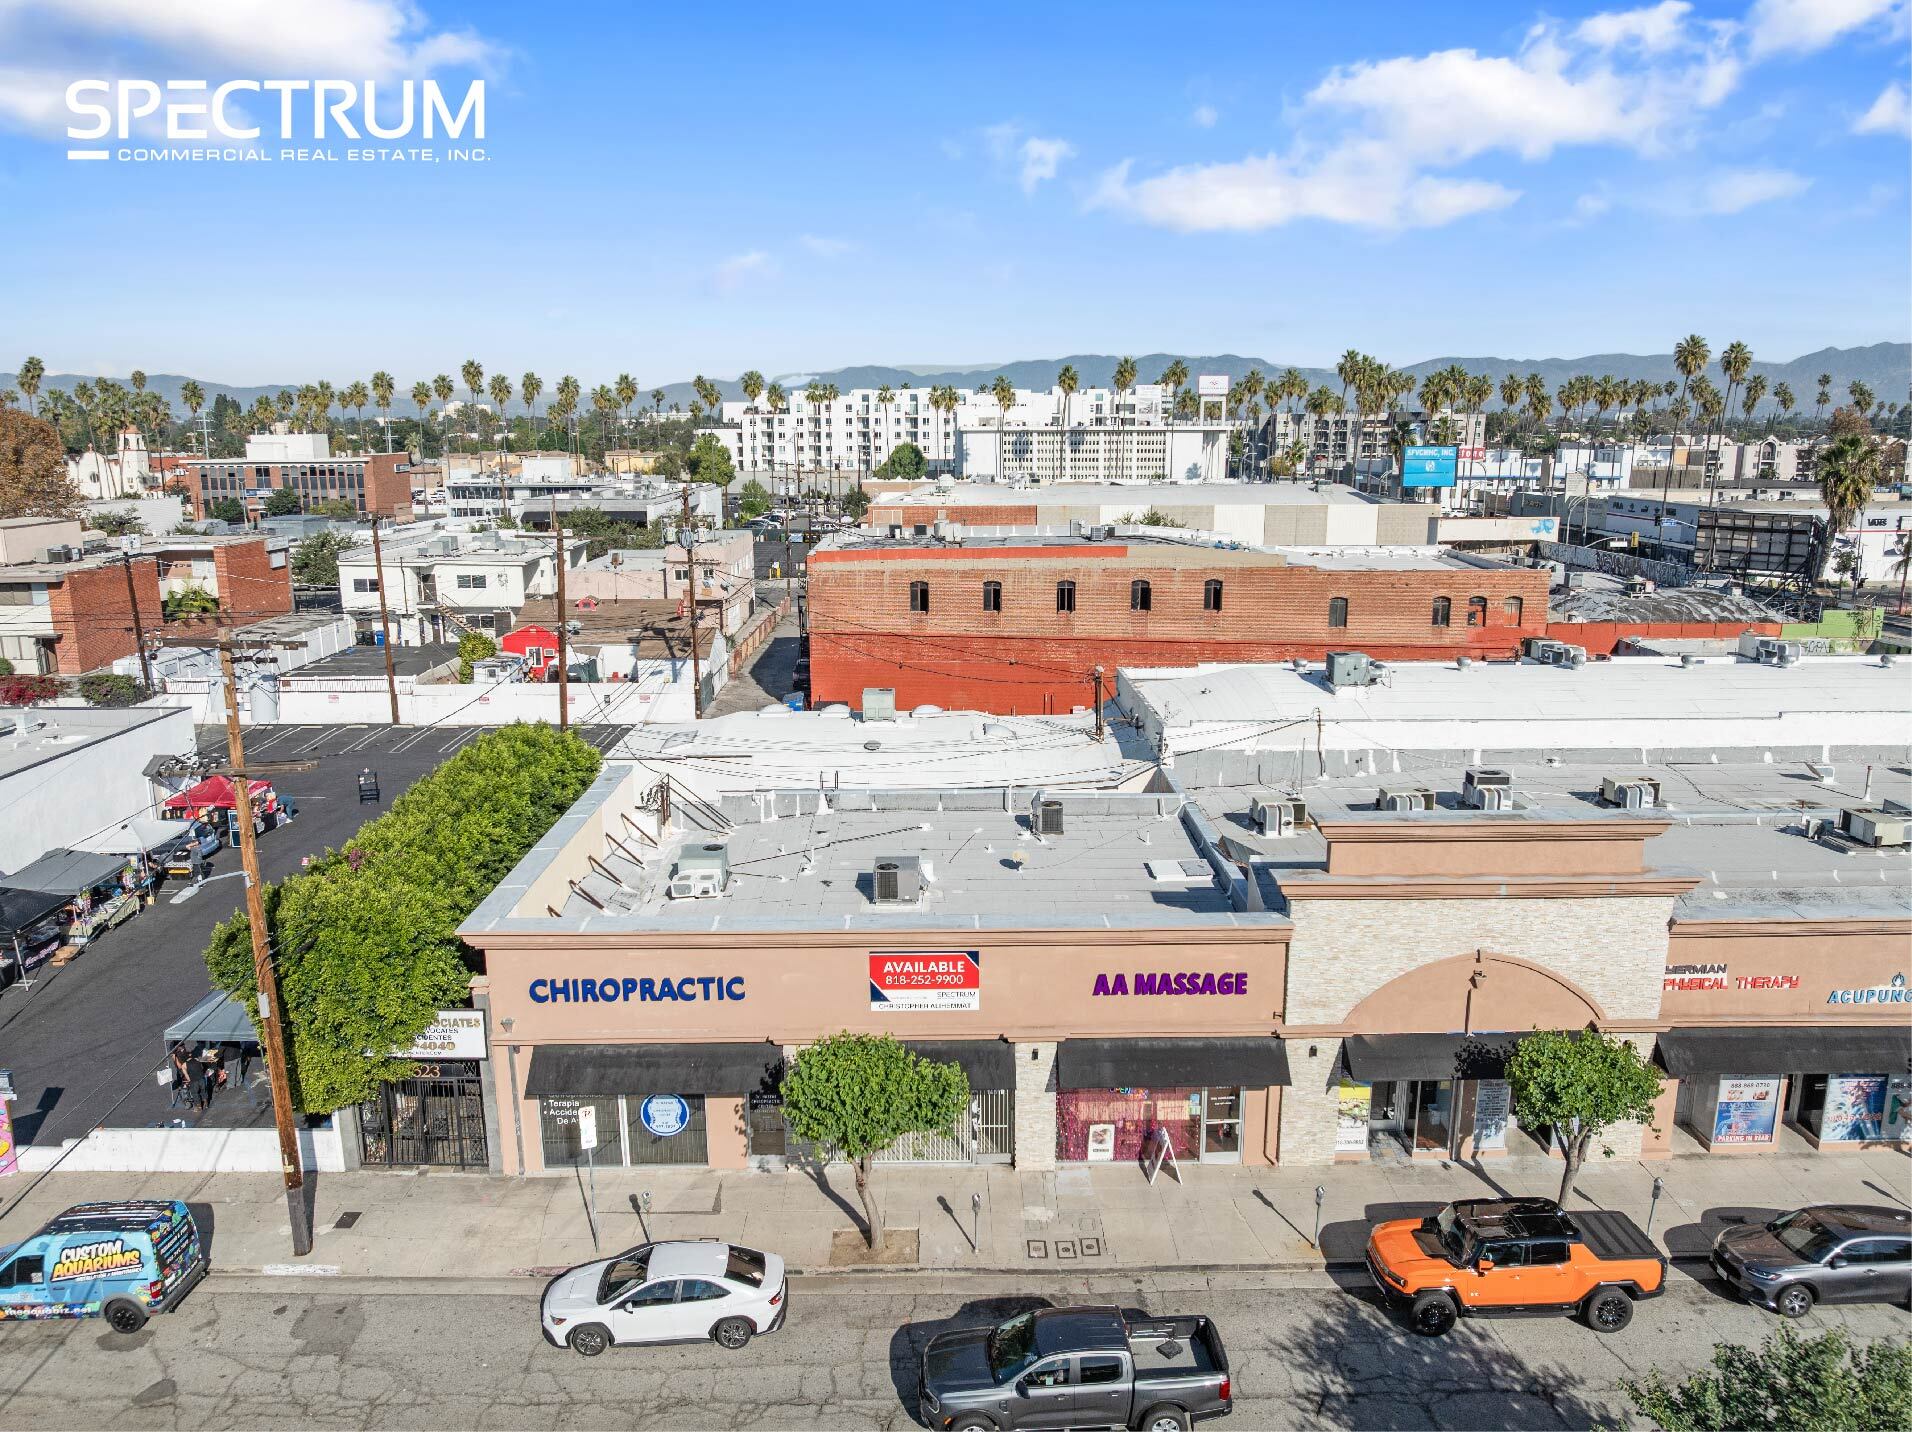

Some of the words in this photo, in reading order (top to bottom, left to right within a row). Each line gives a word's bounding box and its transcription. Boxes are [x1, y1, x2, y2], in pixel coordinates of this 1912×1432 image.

[1867, 518, 1888, 527] VANS
[883, 961, 966, 973] AVAILABLE
[885, 974, 964, 985] 818-252-9900
[1092, 973, 1130, 996] AA
[1133, 972, 1249, 996] MASSAGE
[1663, 976, 1729, 991] PHYSICAL
[1736, 975, 1800, 989] THERAPY
[528, 976, 747, 1004] CHIROPRACTIC
[432, 1018, 481, 1028] OCIATES
[548, 1099, 580, 1109] Terapia
[550, 1108, 579, 1117] Accide
[557, 1116, 569, 1125] De
[60, 1239, 123, 1264] CUSTOM
[53, 1250, 141, 1278] AQUARIUMS
